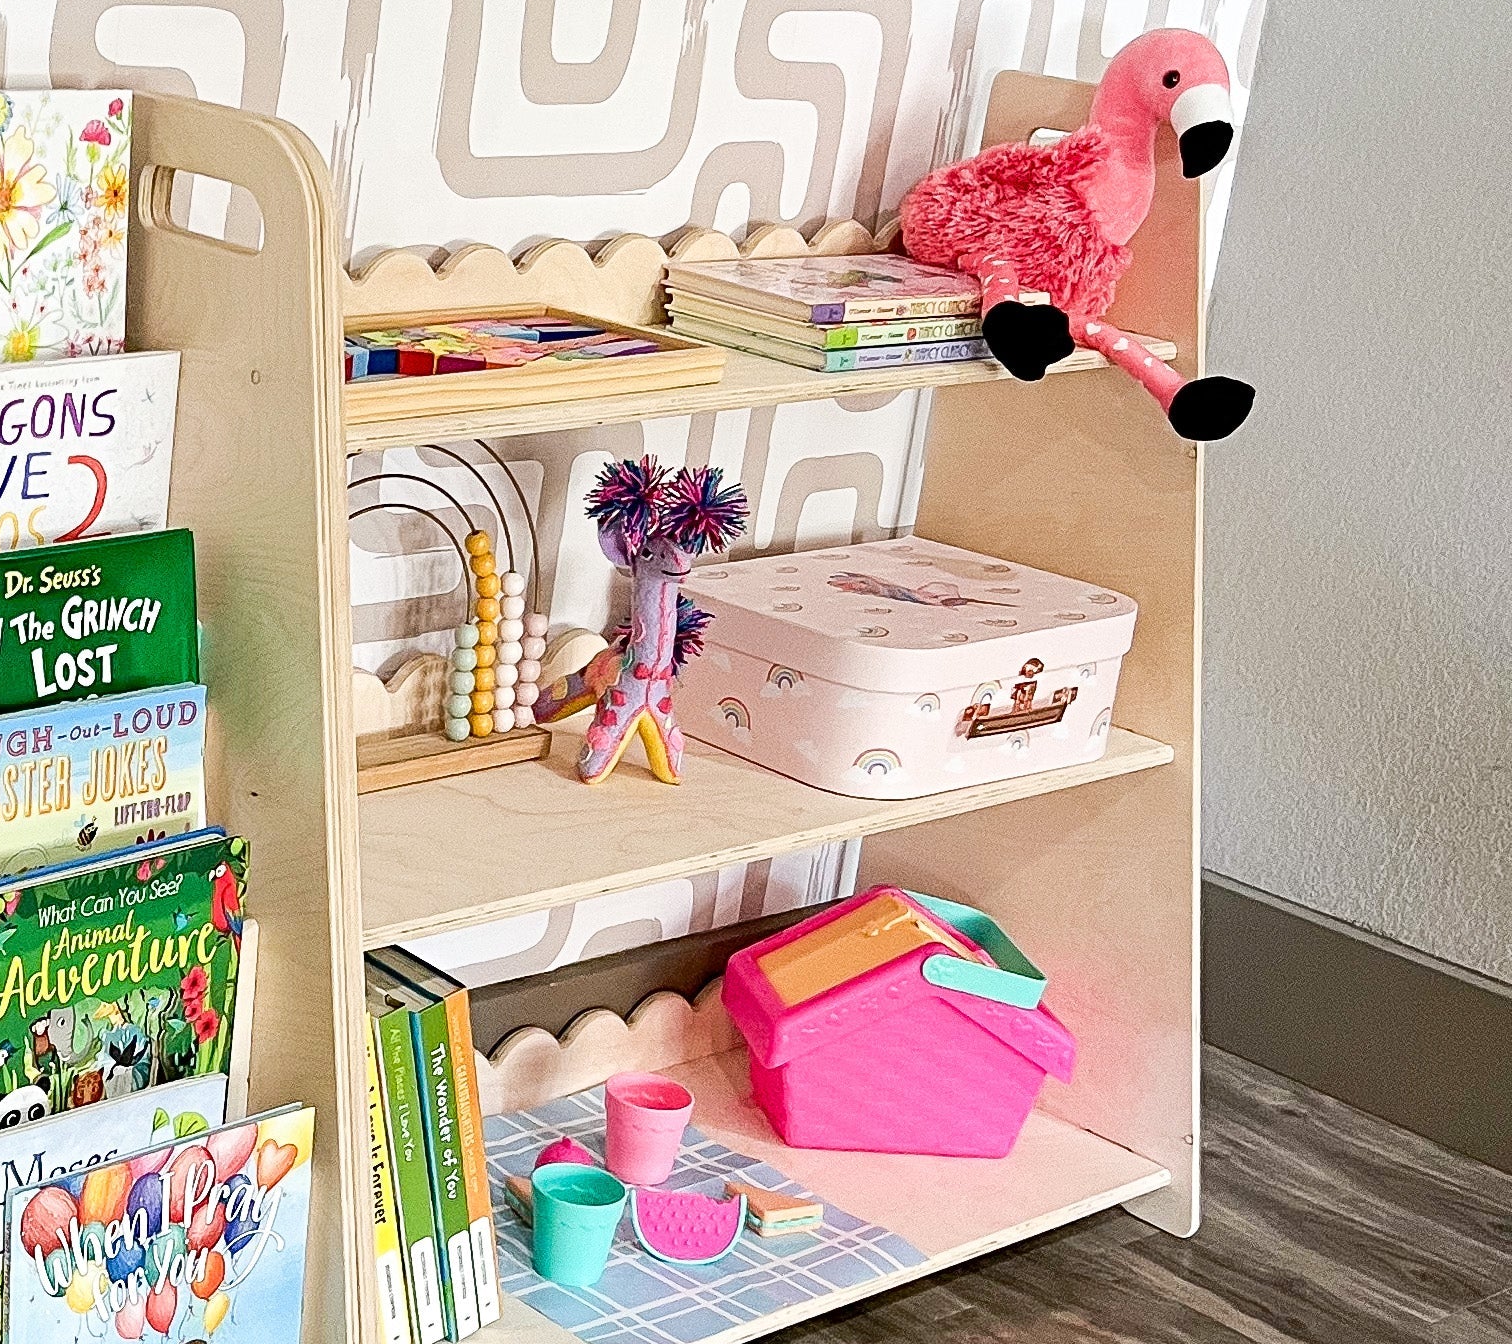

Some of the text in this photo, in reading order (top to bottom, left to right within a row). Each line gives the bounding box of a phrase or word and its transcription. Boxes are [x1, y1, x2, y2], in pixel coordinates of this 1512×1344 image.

[53, 455, 112, 544] 2
[4, 564, 103, 600] Dr. Seuss's
[8, 612, 55, 645] The
[61, 594, 163, 642] GRINCH
[30, 643, 119, 699] LOST
[82, 735, 169, 806] JOKES
[38, 873, 185, 928] What Can You See?
[53, 909, 138, 961] Animal
[393, 1066, 406, 1101] Places
[398, 1103, 408, 1113] I
[399, 1112, 411, 1140] Love
[430, 1042, 461, 1200] The Wonder of You
[403, 1139, 416, 1163] You
[34, 1205, 151, 1298] When
[159, 1169, 173, 1234] I
[185, 1159, 285, 1291] Pray
[90, 1243, 206, 1323] for You
